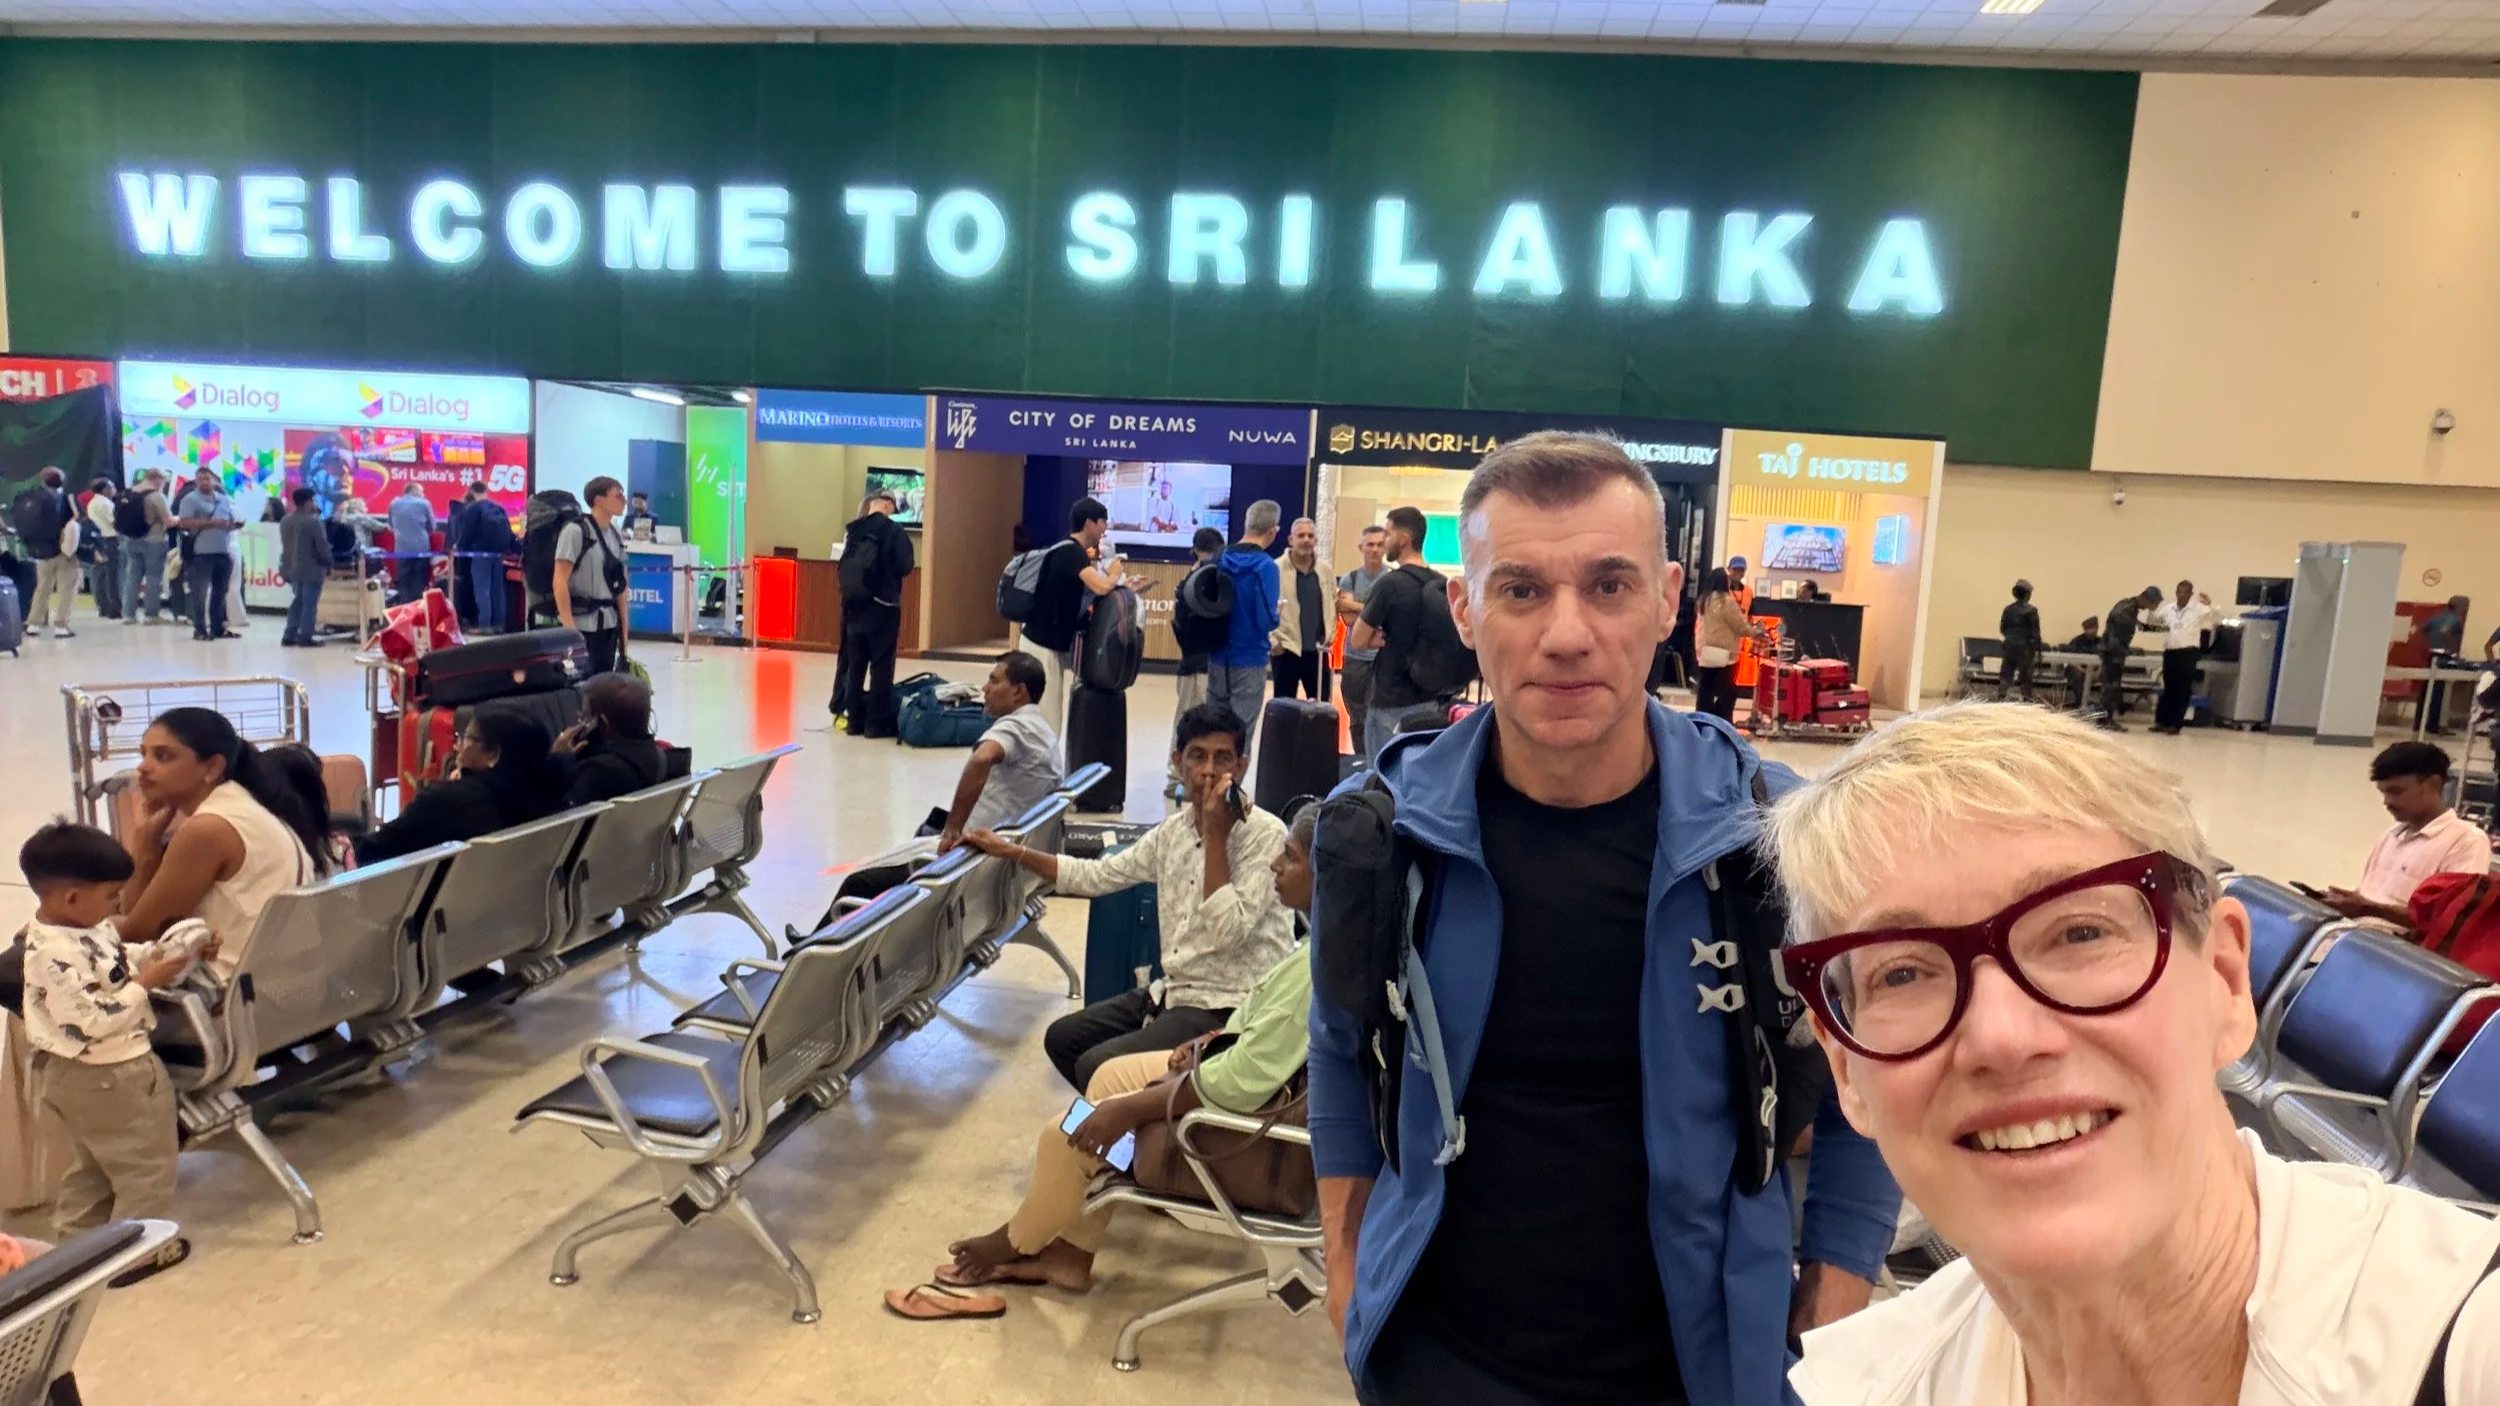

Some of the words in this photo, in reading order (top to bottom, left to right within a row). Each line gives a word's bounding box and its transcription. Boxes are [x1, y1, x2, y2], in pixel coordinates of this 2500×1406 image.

[118, 172, 790, 273] WELCOME
[844, 188, 1007, 278] TO
[1065, 192, 1313, 286] SRI
[1371, 199, 1944, 314] LANKA
[202, 382, 280, 412] Dialog
[389, 390, 470, 421] Dialog
[759, 408, 830, 427] MARINO
[830, 414, 869, 427] HOTELS
[878, 416, 922, 429] RESORTS
[1009, 410, 1056, 427] CITY
[1069, 413, 1096, 429] OF
[1109, 415, 1197, 433] DREAMS
[1065, 436, 1086, 448] SRI
[1093, 438, 1137, 449] LANKA
[1228, 430, 1297, 444] NUWA
[1360, 430, 1498, 454] SHANGRI-LA
[1623, 442, 1719, 465] INGSBURY
[1758, 443, 1804, 479] TAJ
[1808, 457, 1908, 484] HOTELS
[391, 467, 408, 480] Sri
[410, 468, 455, 483] Lanka's
[488, 464, 525, 493] 5G
[626, 588, 664, 604] BITEL
